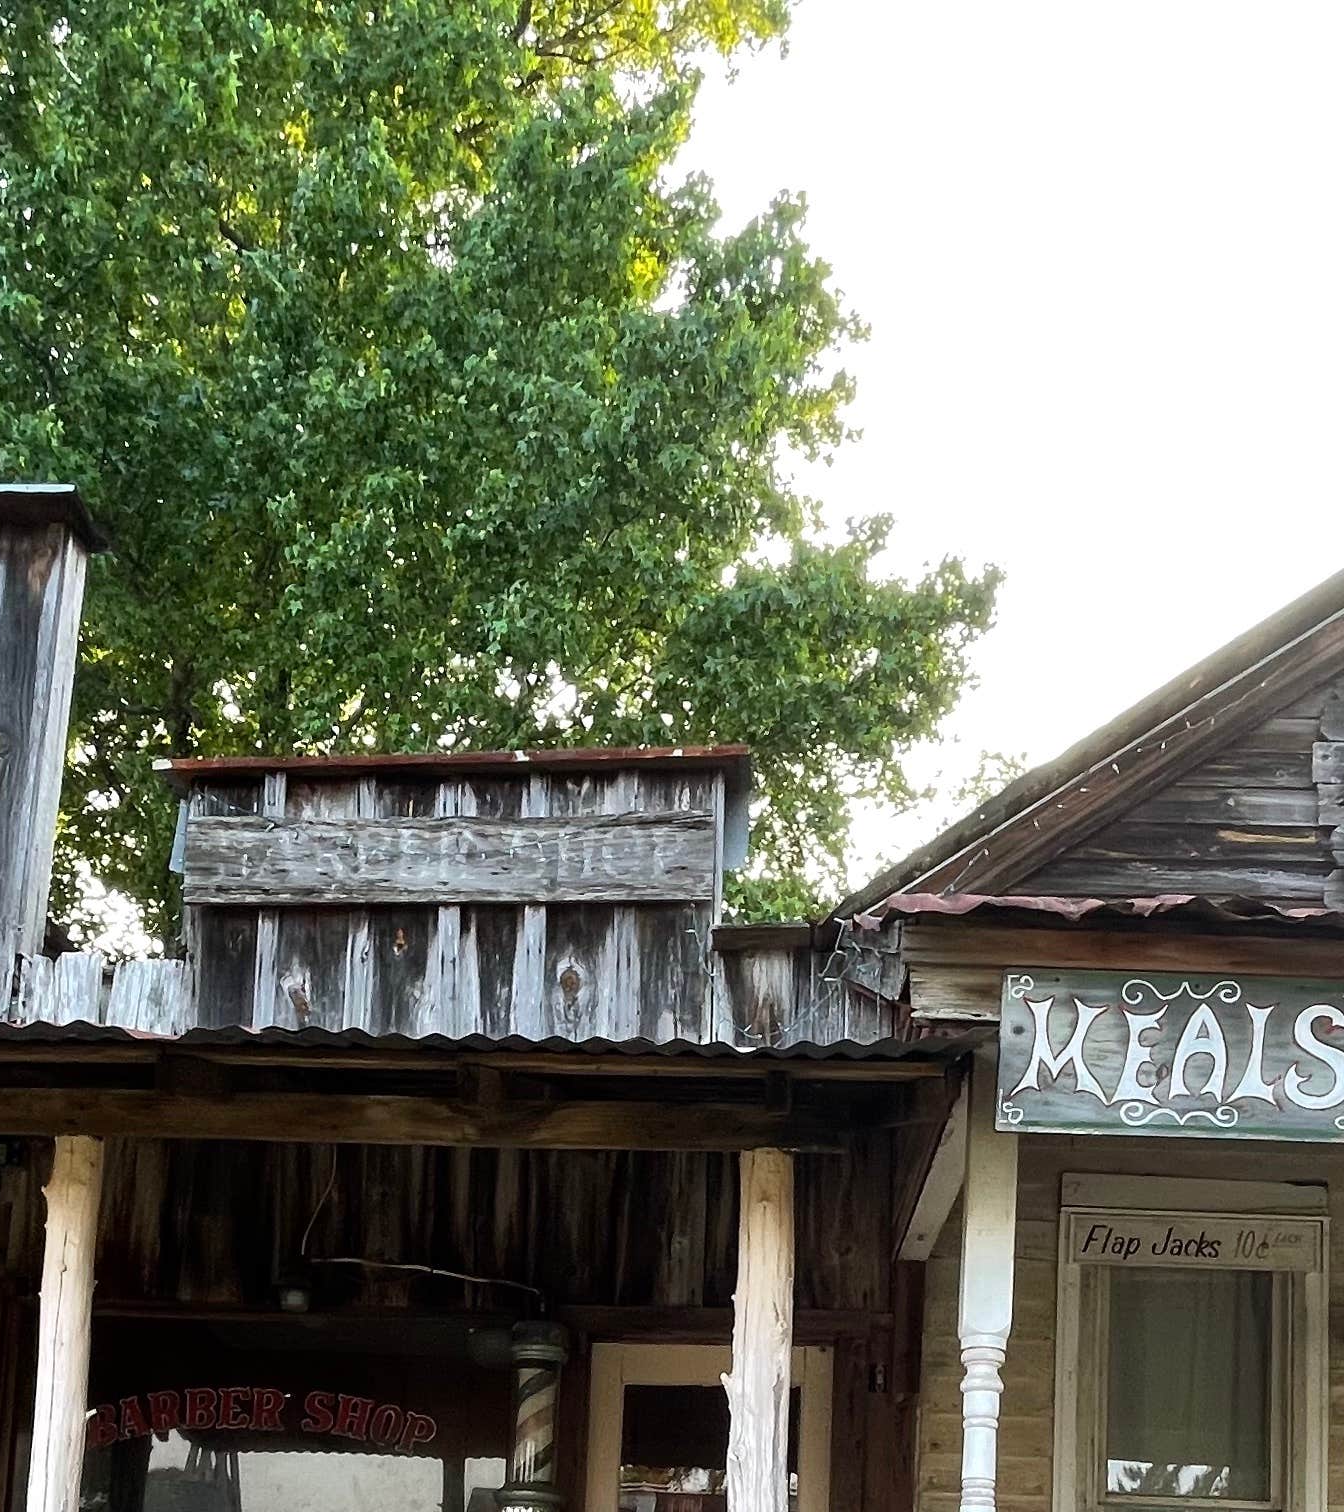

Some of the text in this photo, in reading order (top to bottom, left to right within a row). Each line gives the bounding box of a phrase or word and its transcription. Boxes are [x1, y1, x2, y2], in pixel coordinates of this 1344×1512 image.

[1081, 1224, 1141, 1261] Flap
[1151, 1226, 1222, 1259] Jacks
[89, 1387, 438, 1455] BARBER SHOP
